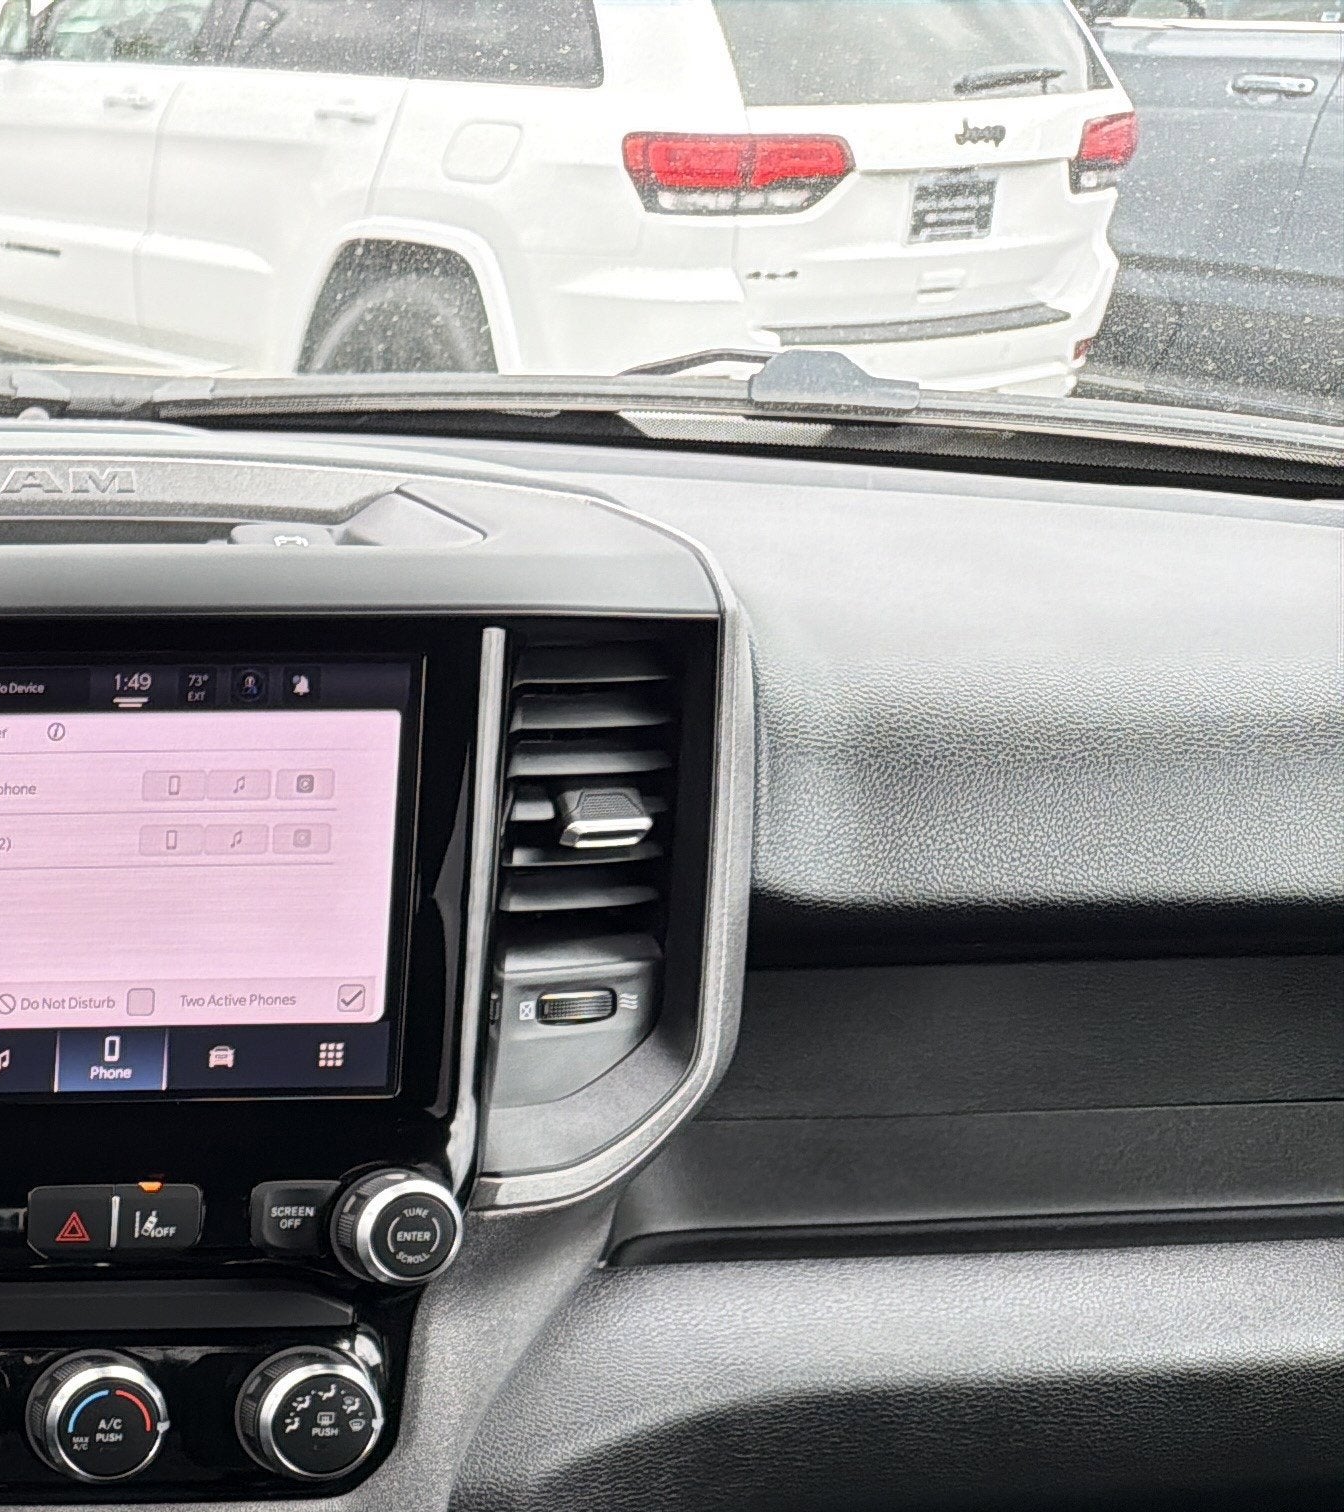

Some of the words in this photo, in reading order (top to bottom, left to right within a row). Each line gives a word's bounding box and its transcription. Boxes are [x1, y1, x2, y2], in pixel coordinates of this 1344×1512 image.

[9, 682, 45, 695] Device
[113, 672, 152, 692] 1:49
[20, 997, 40, 1011] Do
[42, 997, 66, 1010] Not
[68, 995, 116, 1010] Disturb
[180, 994, 206, 1008] Two
[207, 991, 245, 1008] Active
[247, 991, 297, 1008] Phones
[89, 1065, 133, 1081] Phone
[270, 1205, 316, 1218] SCREEN
[402, 1207, 430, 1219] TUNE
[279, 1218, 302, 1230] OFF
[154, 1226, 178, 1238] OFF
[396, 1230, 432, 1242] ENTER
[395, 1250, 431, 1264] SCROLL
[97, 1416, 123, 1430] A/C
[95, 1432, 123, 1443] PUSH
[311, 1427, 339, 1437] PUSH
